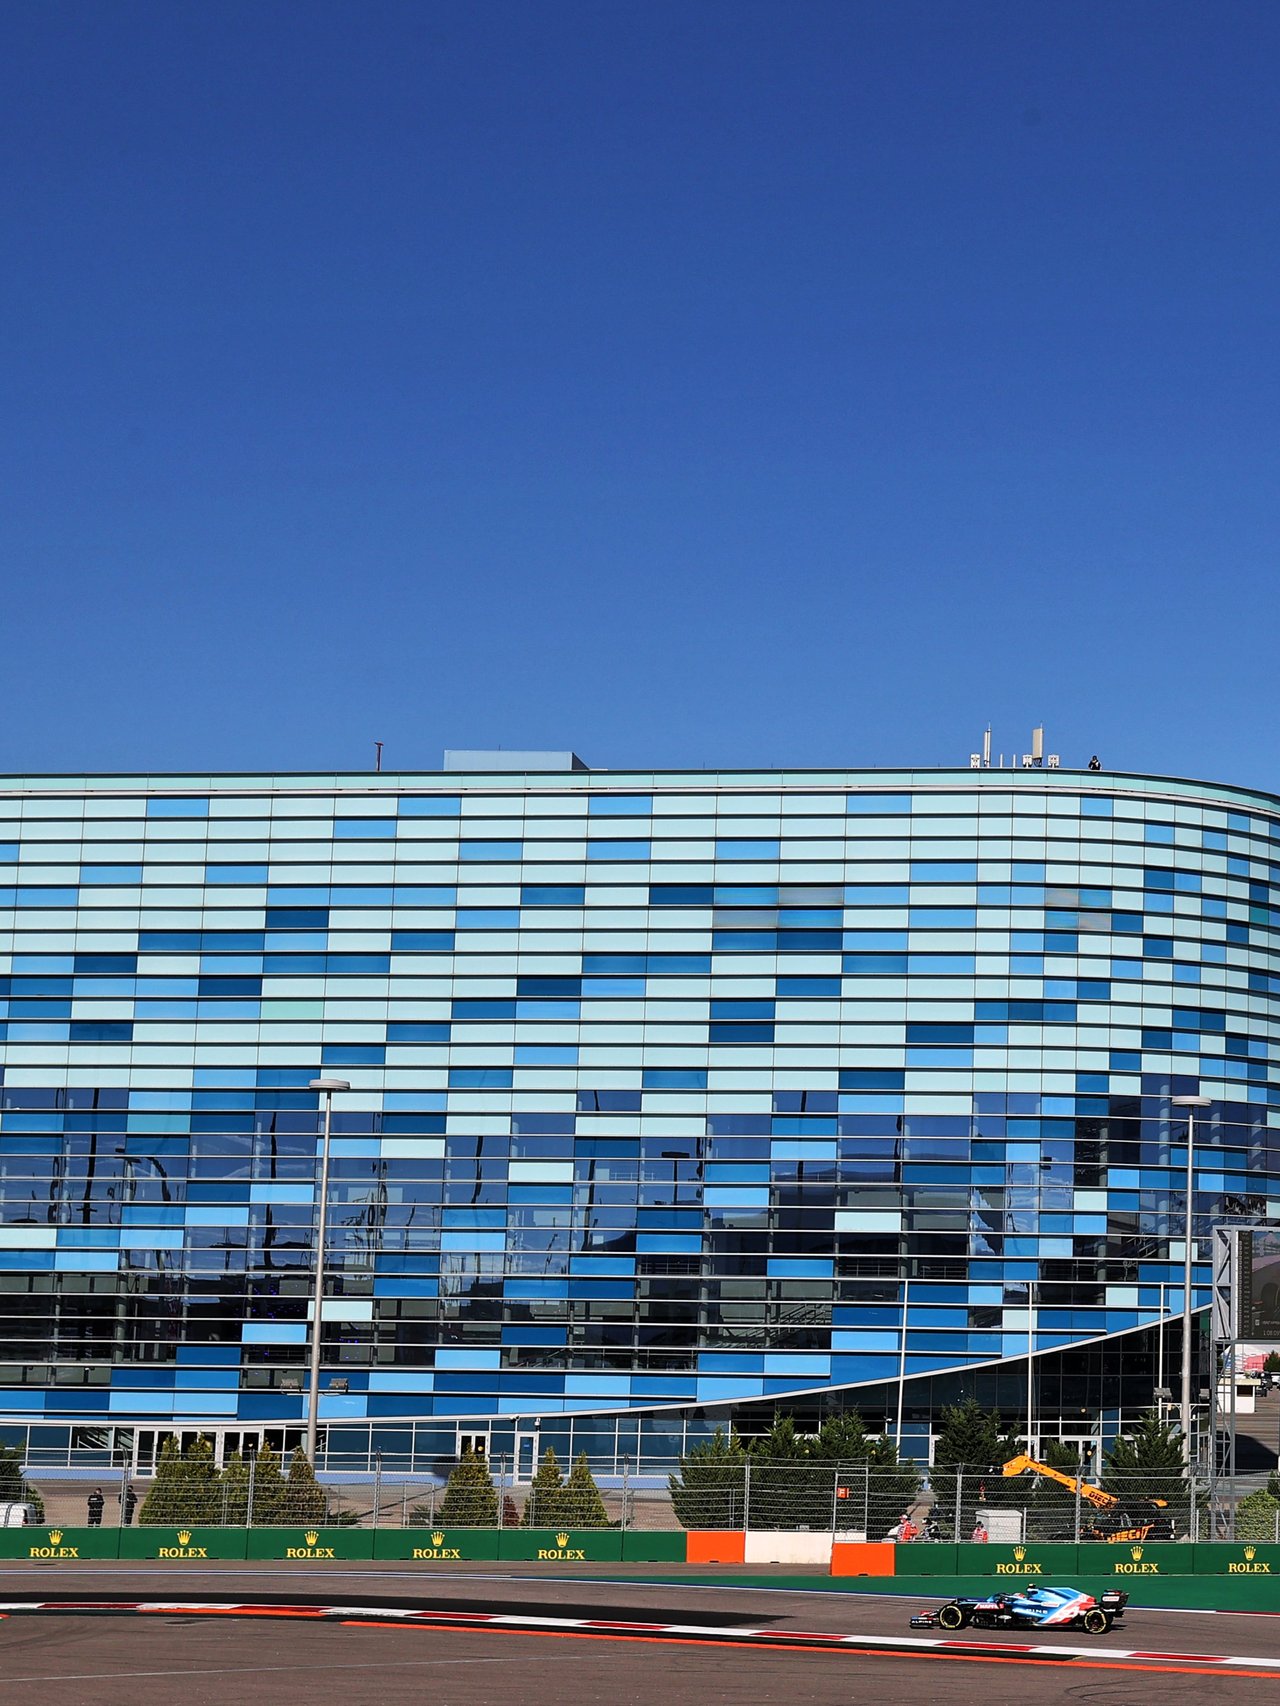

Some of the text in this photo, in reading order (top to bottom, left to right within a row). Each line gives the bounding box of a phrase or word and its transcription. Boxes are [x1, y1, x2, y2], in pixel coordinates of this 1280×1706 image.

[29, 1547, 79, 1558] ROLEX
[159, 1548, 207, 1558] ROLEX
[286, 1548, 334, 1558] ROLEX
[413, 1549, 460, 1559] ROLEX
[538, 1550, 585, 1560] ROLEX
[996, 1563, 1042, 1574] ROLEX
[1115, 1563, 1158, 1573] ROLEX
[1228, 1563, 1270, 1573] ROLEX
